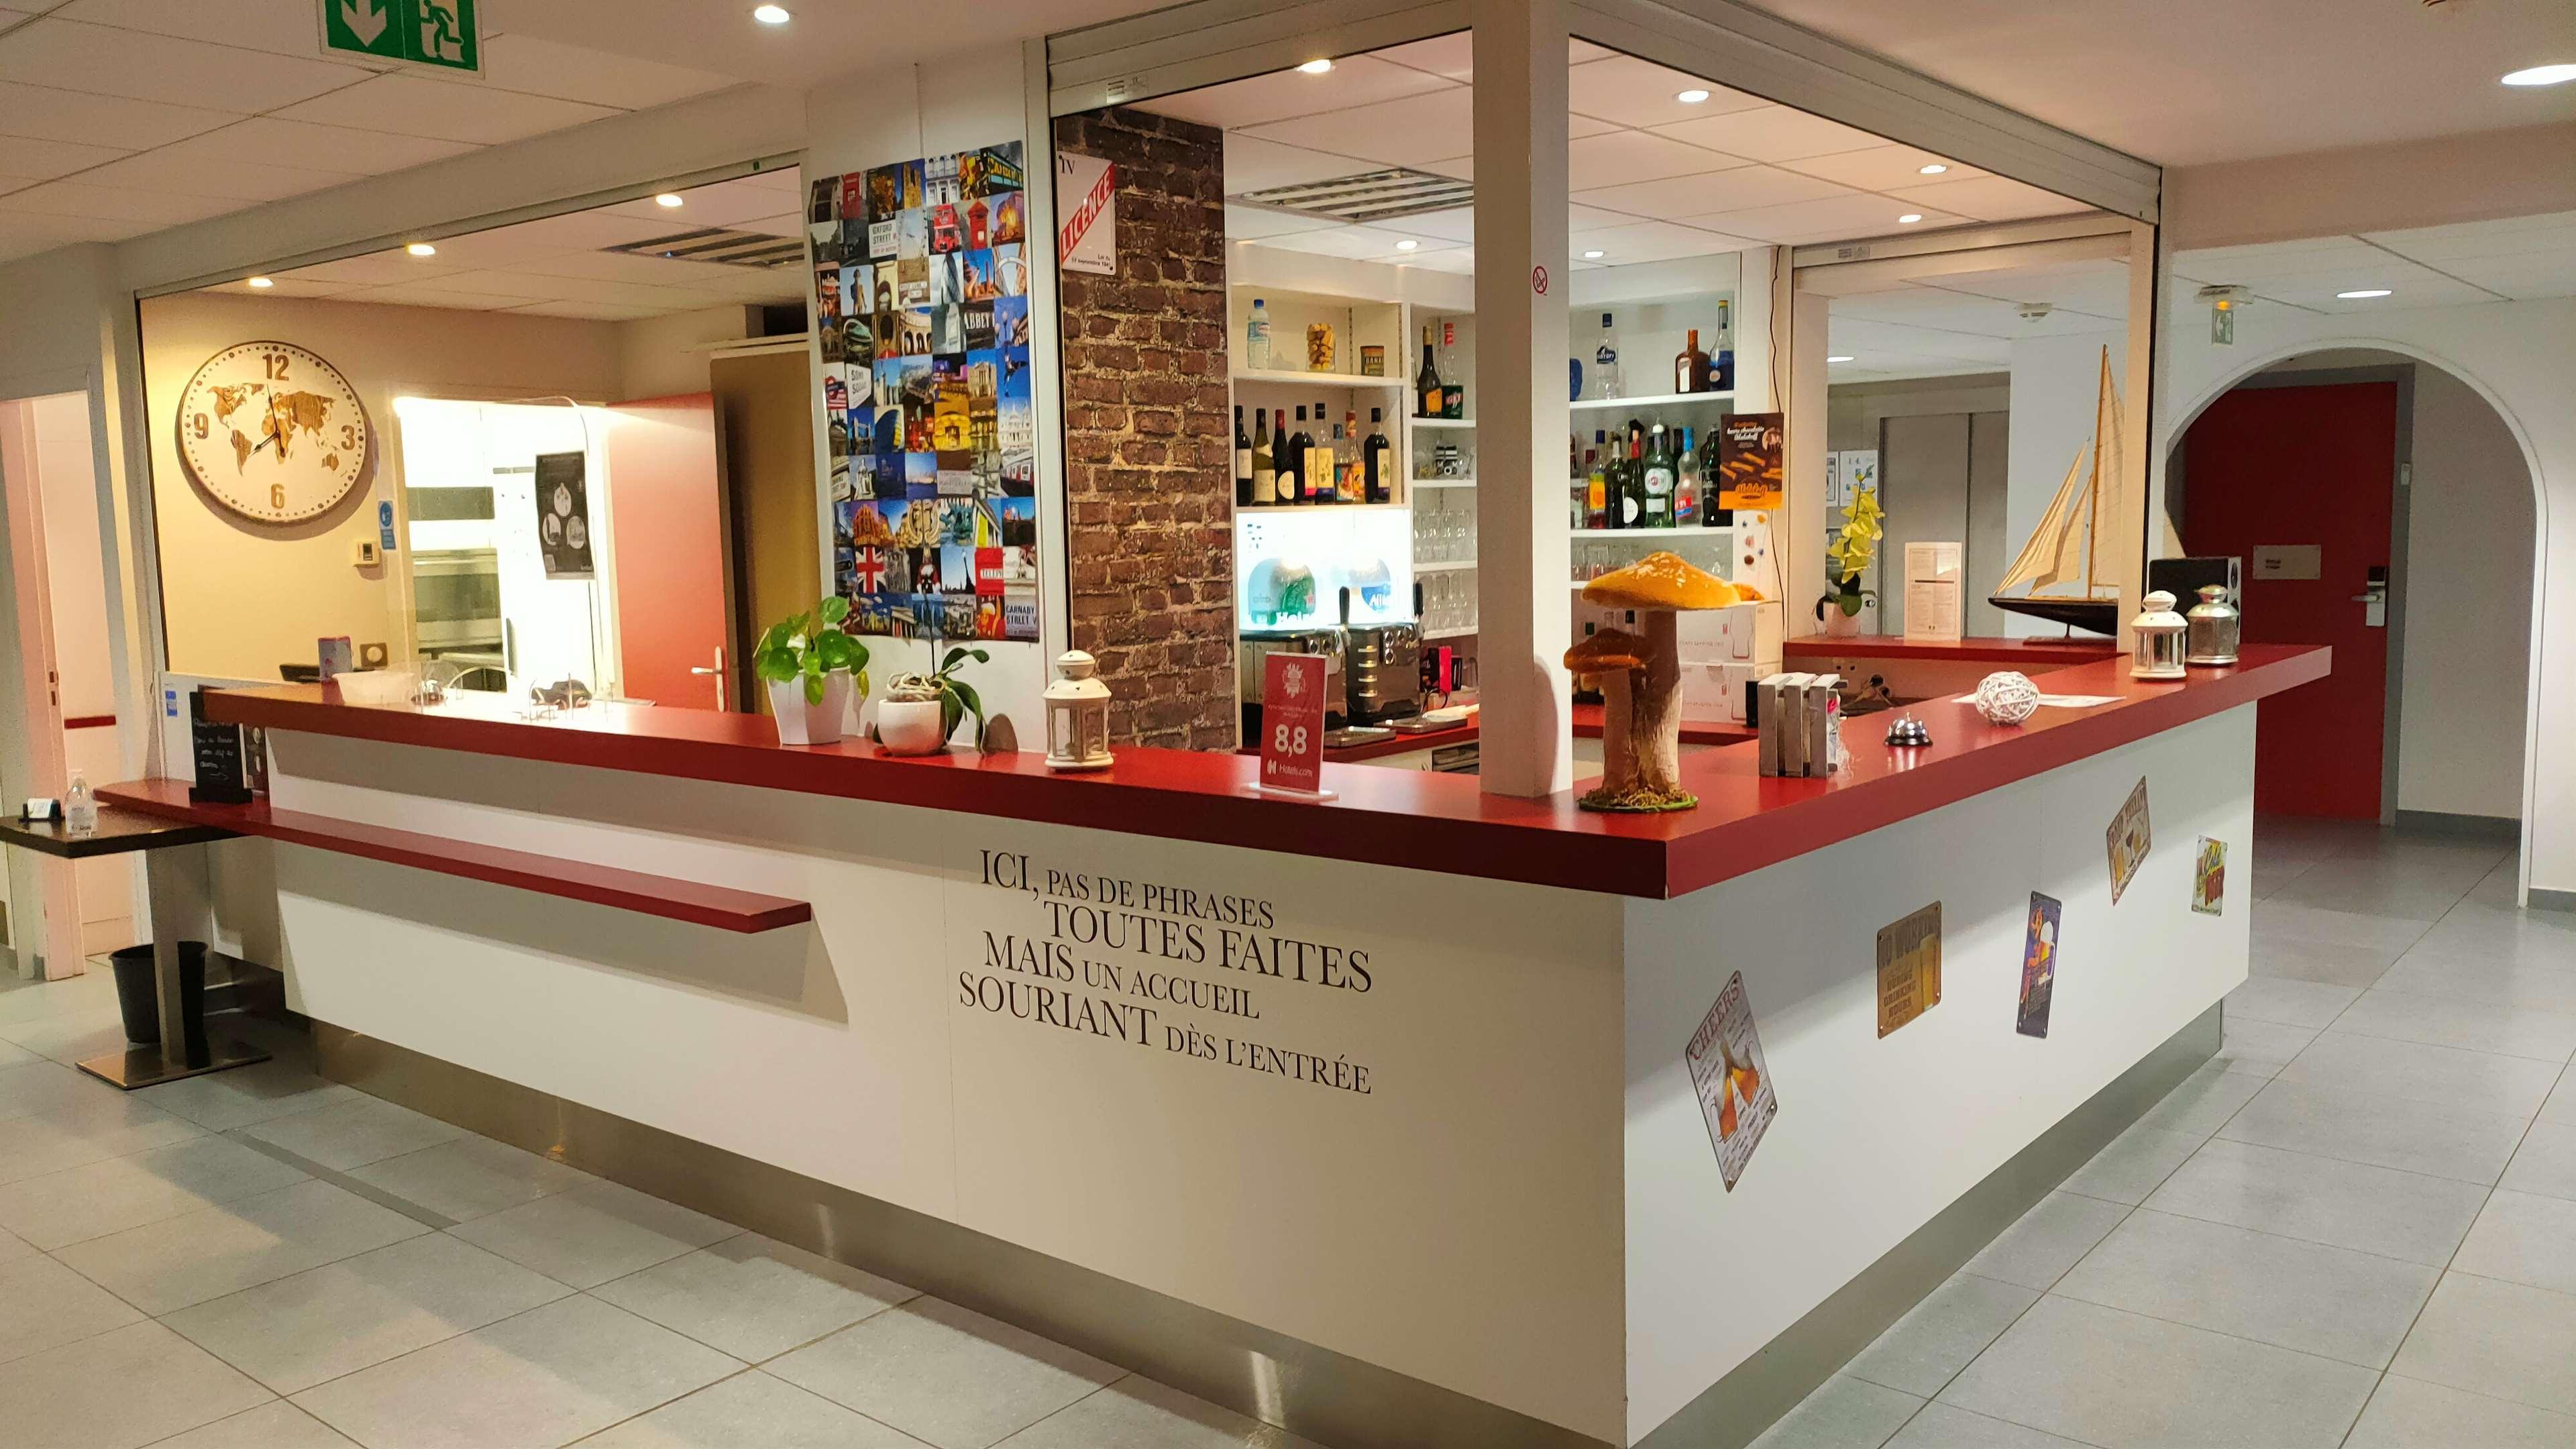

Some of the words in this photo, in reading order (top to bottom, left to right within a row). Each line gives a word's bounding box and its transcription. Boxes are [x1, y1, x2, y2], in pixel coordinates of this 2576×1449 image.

[1061, 158, 1075, 175] IV
[1062, 169, 1111, 258] LICENCE
[262, 354, 290, 382] 12
[193, 413, 209, 440] 9
[341, 425, 356, 451] 3
[270, 483, 286, 510] 6
[1006, 604, 1035, 615] CARNABY
[1275, 723, 1307, 758] 8,8
[1279, 763, 1313, 778] Hotels.com
[979, 849, 1039, 901] ICI,
[1046, 869, 1089, 901] PAS
[1097, 877, 1135, 908] DE
[1143, 883, 1275, 930] PHRASES
[1043, 900, 1206, 964] TOUTES
[1219, 928, 1373, 994] FAITES
[982, 930, 1075, 982] MAIS
[1082, 959, 1123, 991] UN
[1130, 970, 1260, 1020] ACCUEIL
[959, 971, 1158, 1047] SOURIANT
[1165, 1023, 1218, 1061] DÈS
[1689, 981, 1741, 1061] CHEERS
